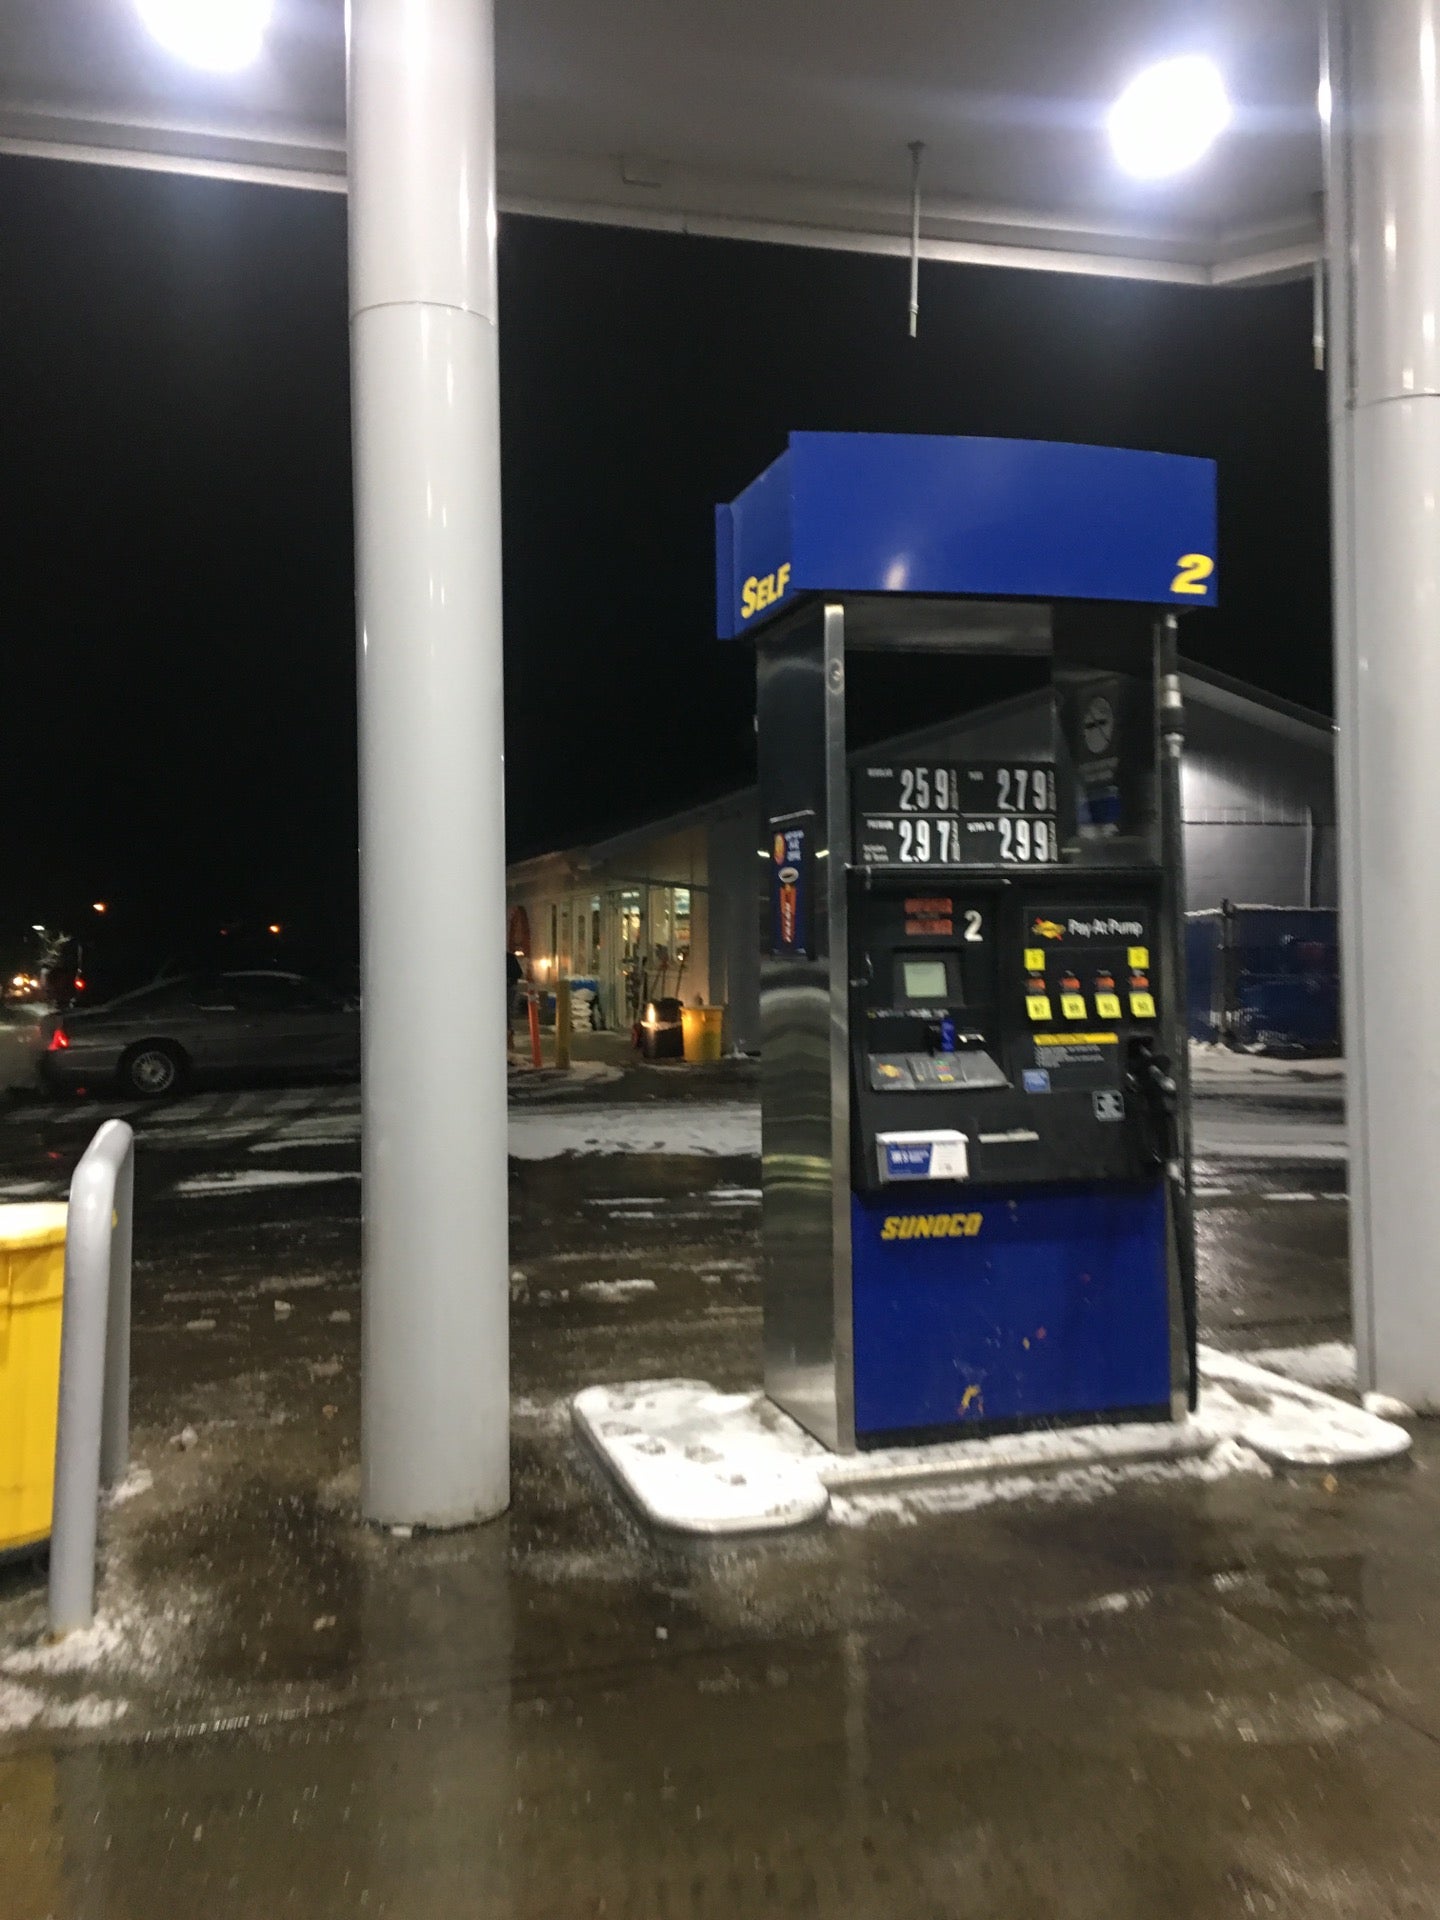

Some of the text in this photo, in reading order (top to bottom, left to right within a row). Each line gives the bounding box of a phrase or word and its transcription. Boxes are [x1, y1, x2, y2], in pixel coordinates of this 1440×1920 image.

[741, 563, 791, 619] SELF
[1170, 553, 1215, 595] 2
[963, 910, 984, 942] 2
[880, 1211, 984, 1241] SUNOCO
